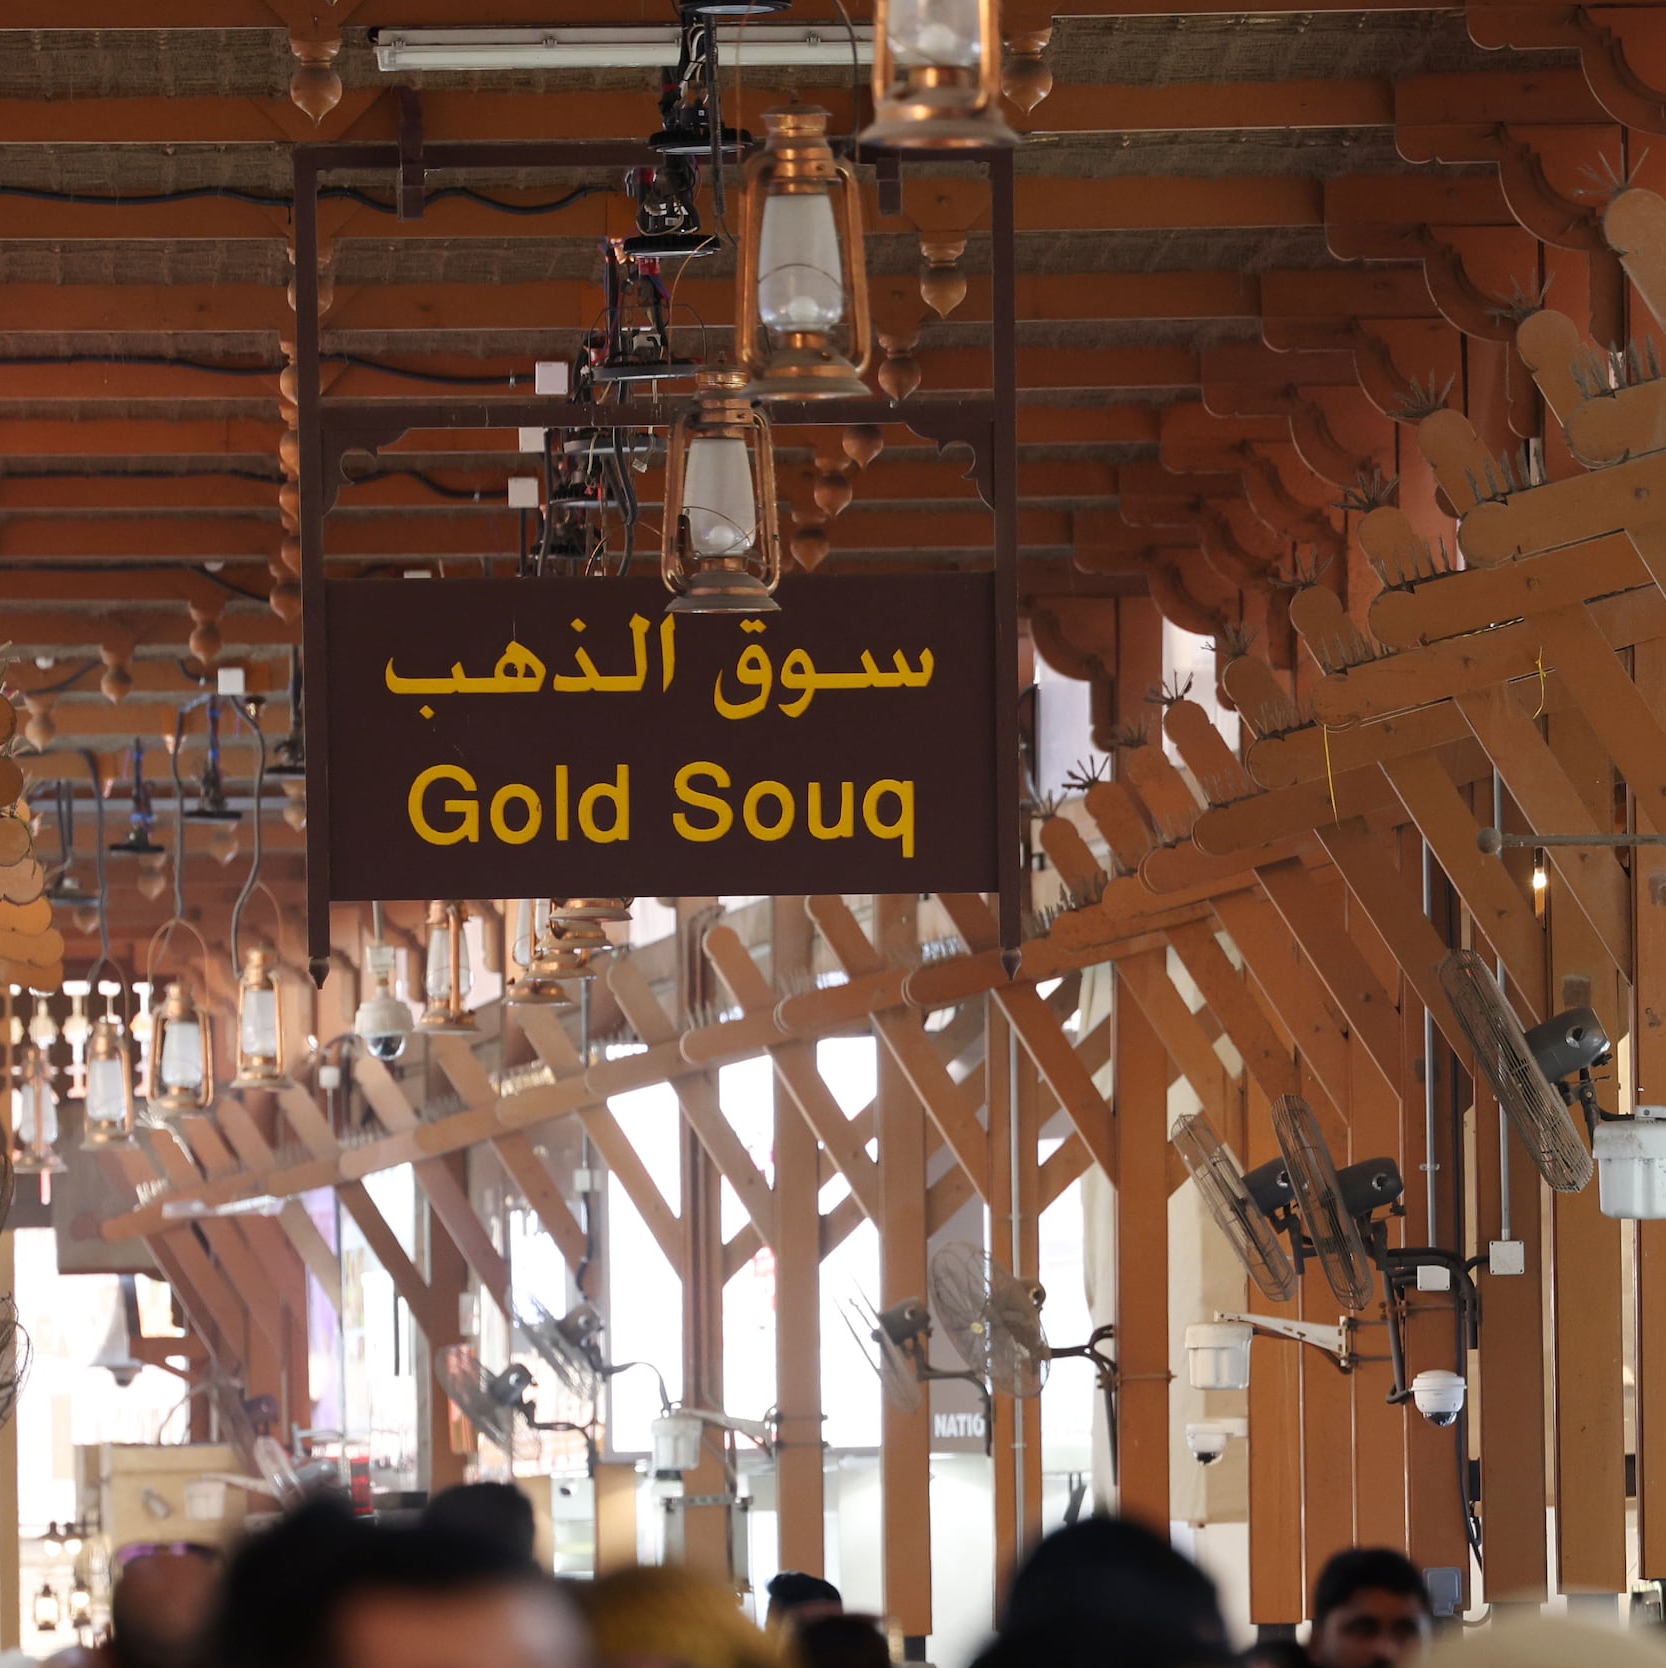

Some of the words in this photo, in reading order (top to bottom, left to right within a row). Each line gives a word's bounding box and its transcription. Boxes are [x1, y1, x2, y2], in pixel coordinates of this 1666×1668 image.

[384, 613, 676, 719] الذهب
[713, 619, 935, 720] سوق
[407, 763, 631, 846] Gold
[671, 760, 916, 858] Souq
